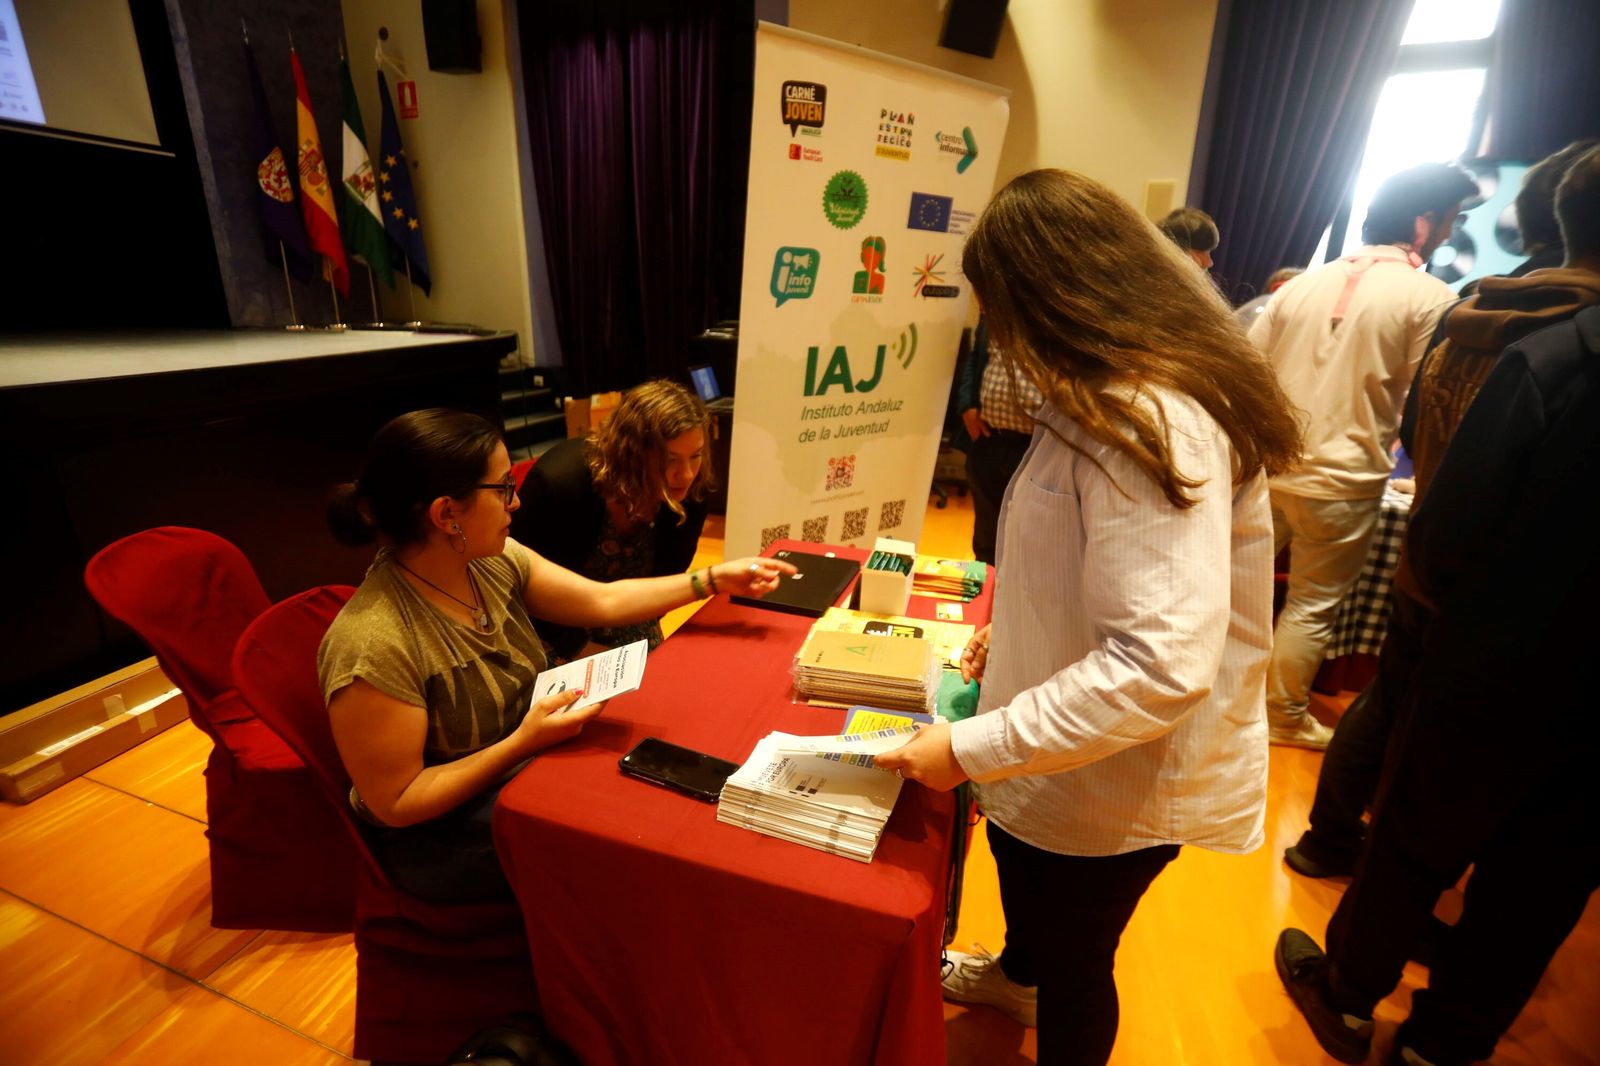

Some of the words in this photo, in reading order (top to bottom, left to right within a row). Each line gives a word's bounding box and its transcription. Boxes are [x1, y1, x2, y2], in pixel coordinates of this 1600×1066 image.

[786, 85, 816, 100] CARNÉ
[786, 102, 822, 121] JOVEN
[789, 273, 811, 286] info
[803, 344, 887, 397] IAJ
[801, 405, 853, 421] Instituto
[855, 398, 904, 415] Andaluz
[799, 428, 816, 443] de
[820, 426, 831, 441] la
[834, 419, 890, 438] Juventud
